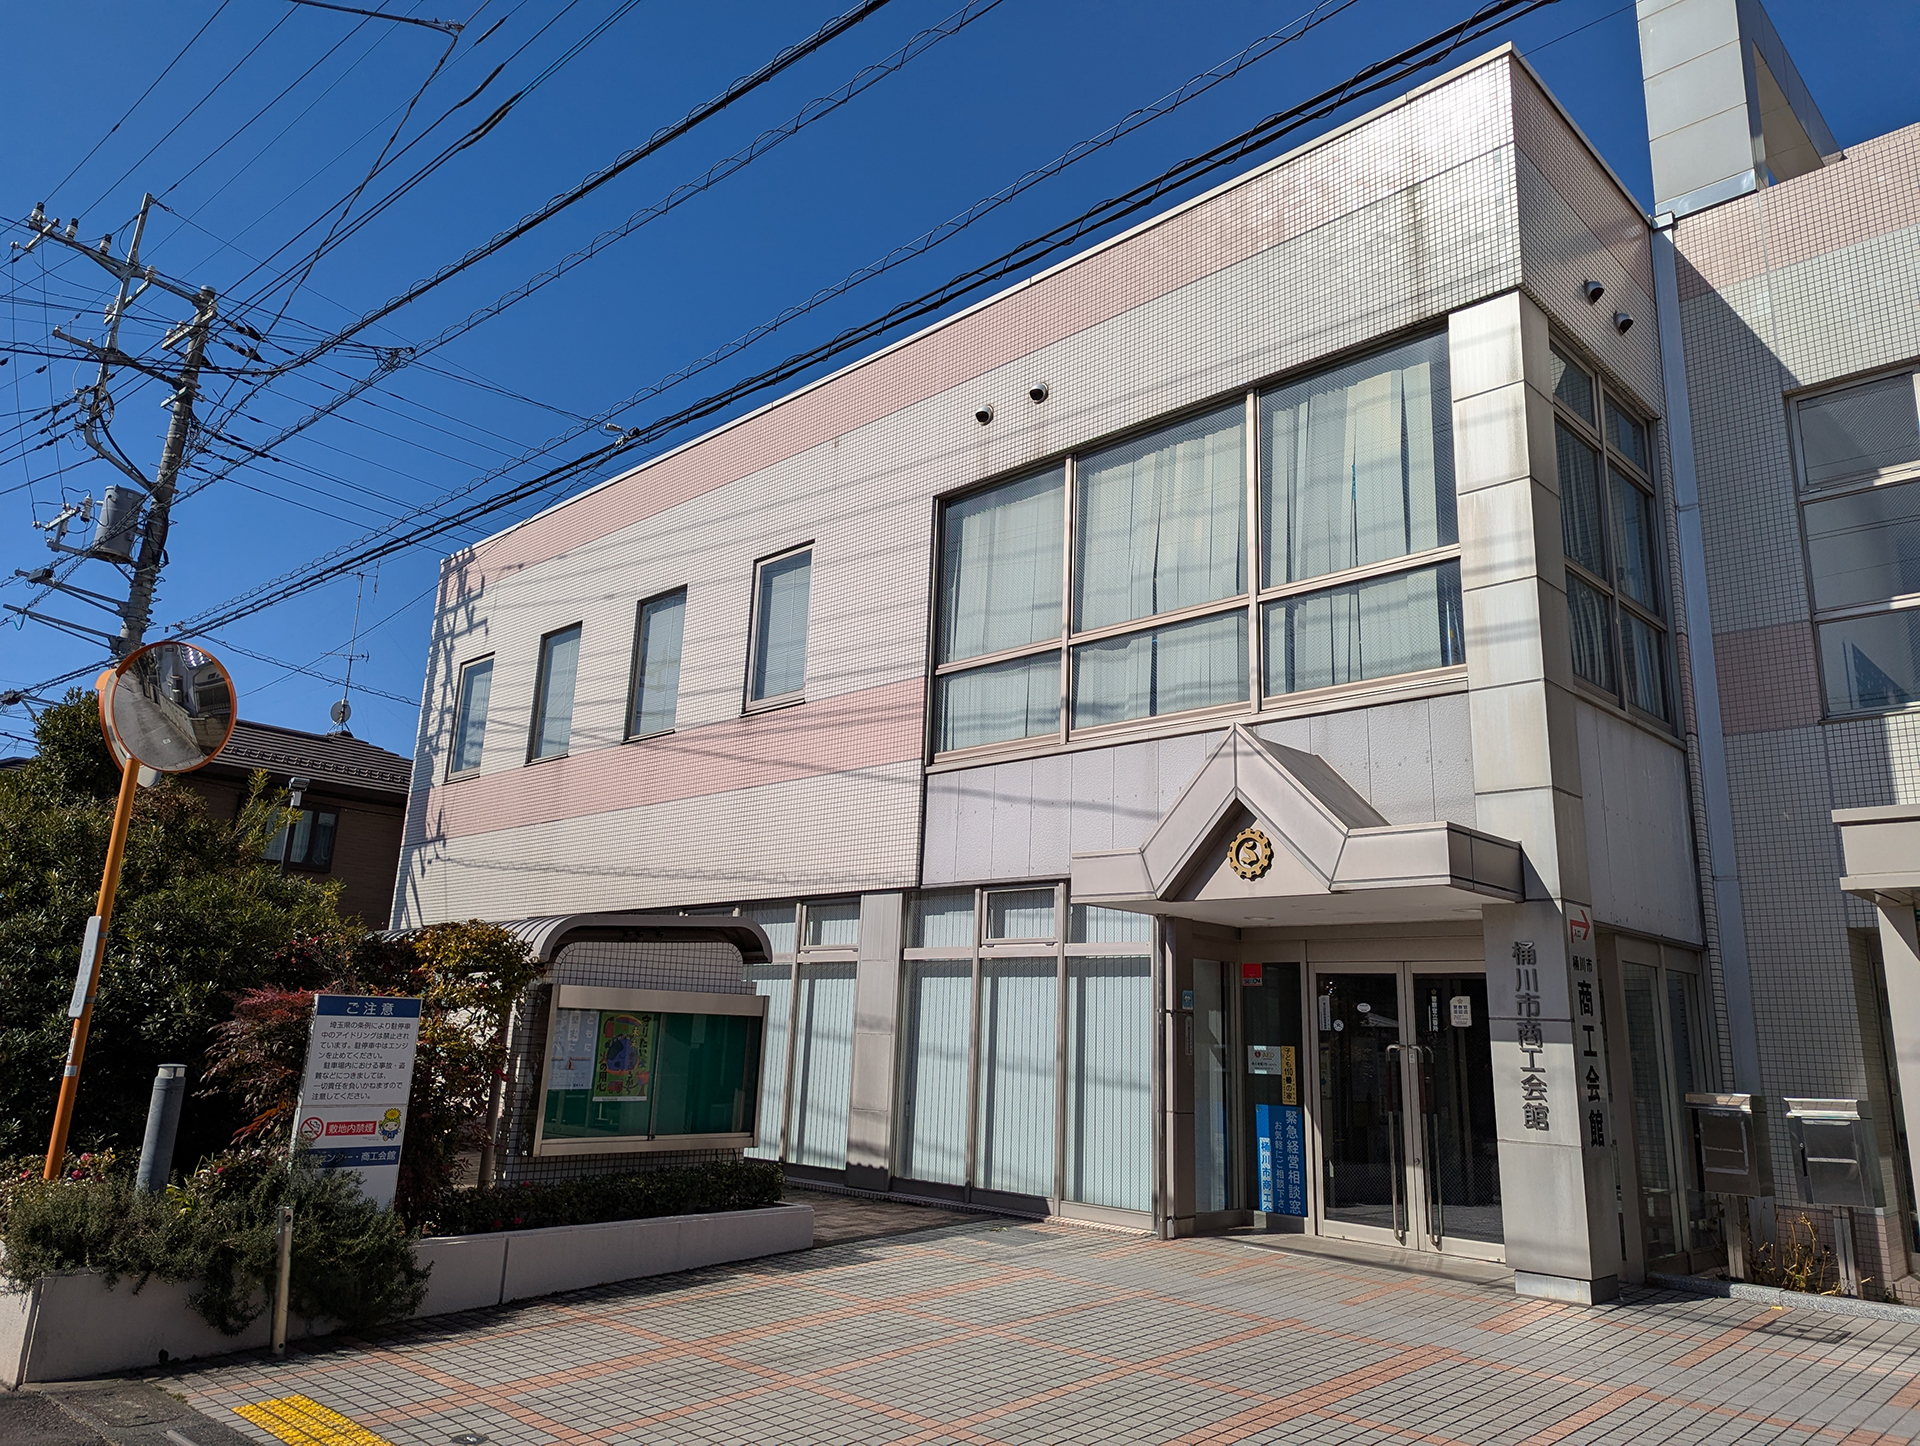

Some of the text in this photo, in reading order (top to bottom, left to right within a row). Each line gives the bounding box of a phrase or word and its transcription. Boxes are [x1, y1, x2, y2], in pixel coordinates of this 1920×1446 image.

[1572, 955, 1593, 973] 桶川市
[346, 1001, 395, 1016] ご注意
[329, 1021, 411, 1030] 埼玉県の条例により駐停車
[321, 1031, 410, 1040] 中のアイドリングは禁止され
[1511, 940, 1550, 1132] 桶川市商工会館
[320, 1041, 409, 1050] ています。駐停車中はエンジ
[318, 1052, 383, 1060] ンを止めてください。
[1577, 979, 1606, 1148] 商工会館
[596, 1051, 608, 1093] 火の用心
[313, 1081, 403, 1090] 一切責任を負いかねますので
[311, 1092, 371, 1101] 注意してください。
[328, 1123, 374, 1134] 敷地内禁煙
